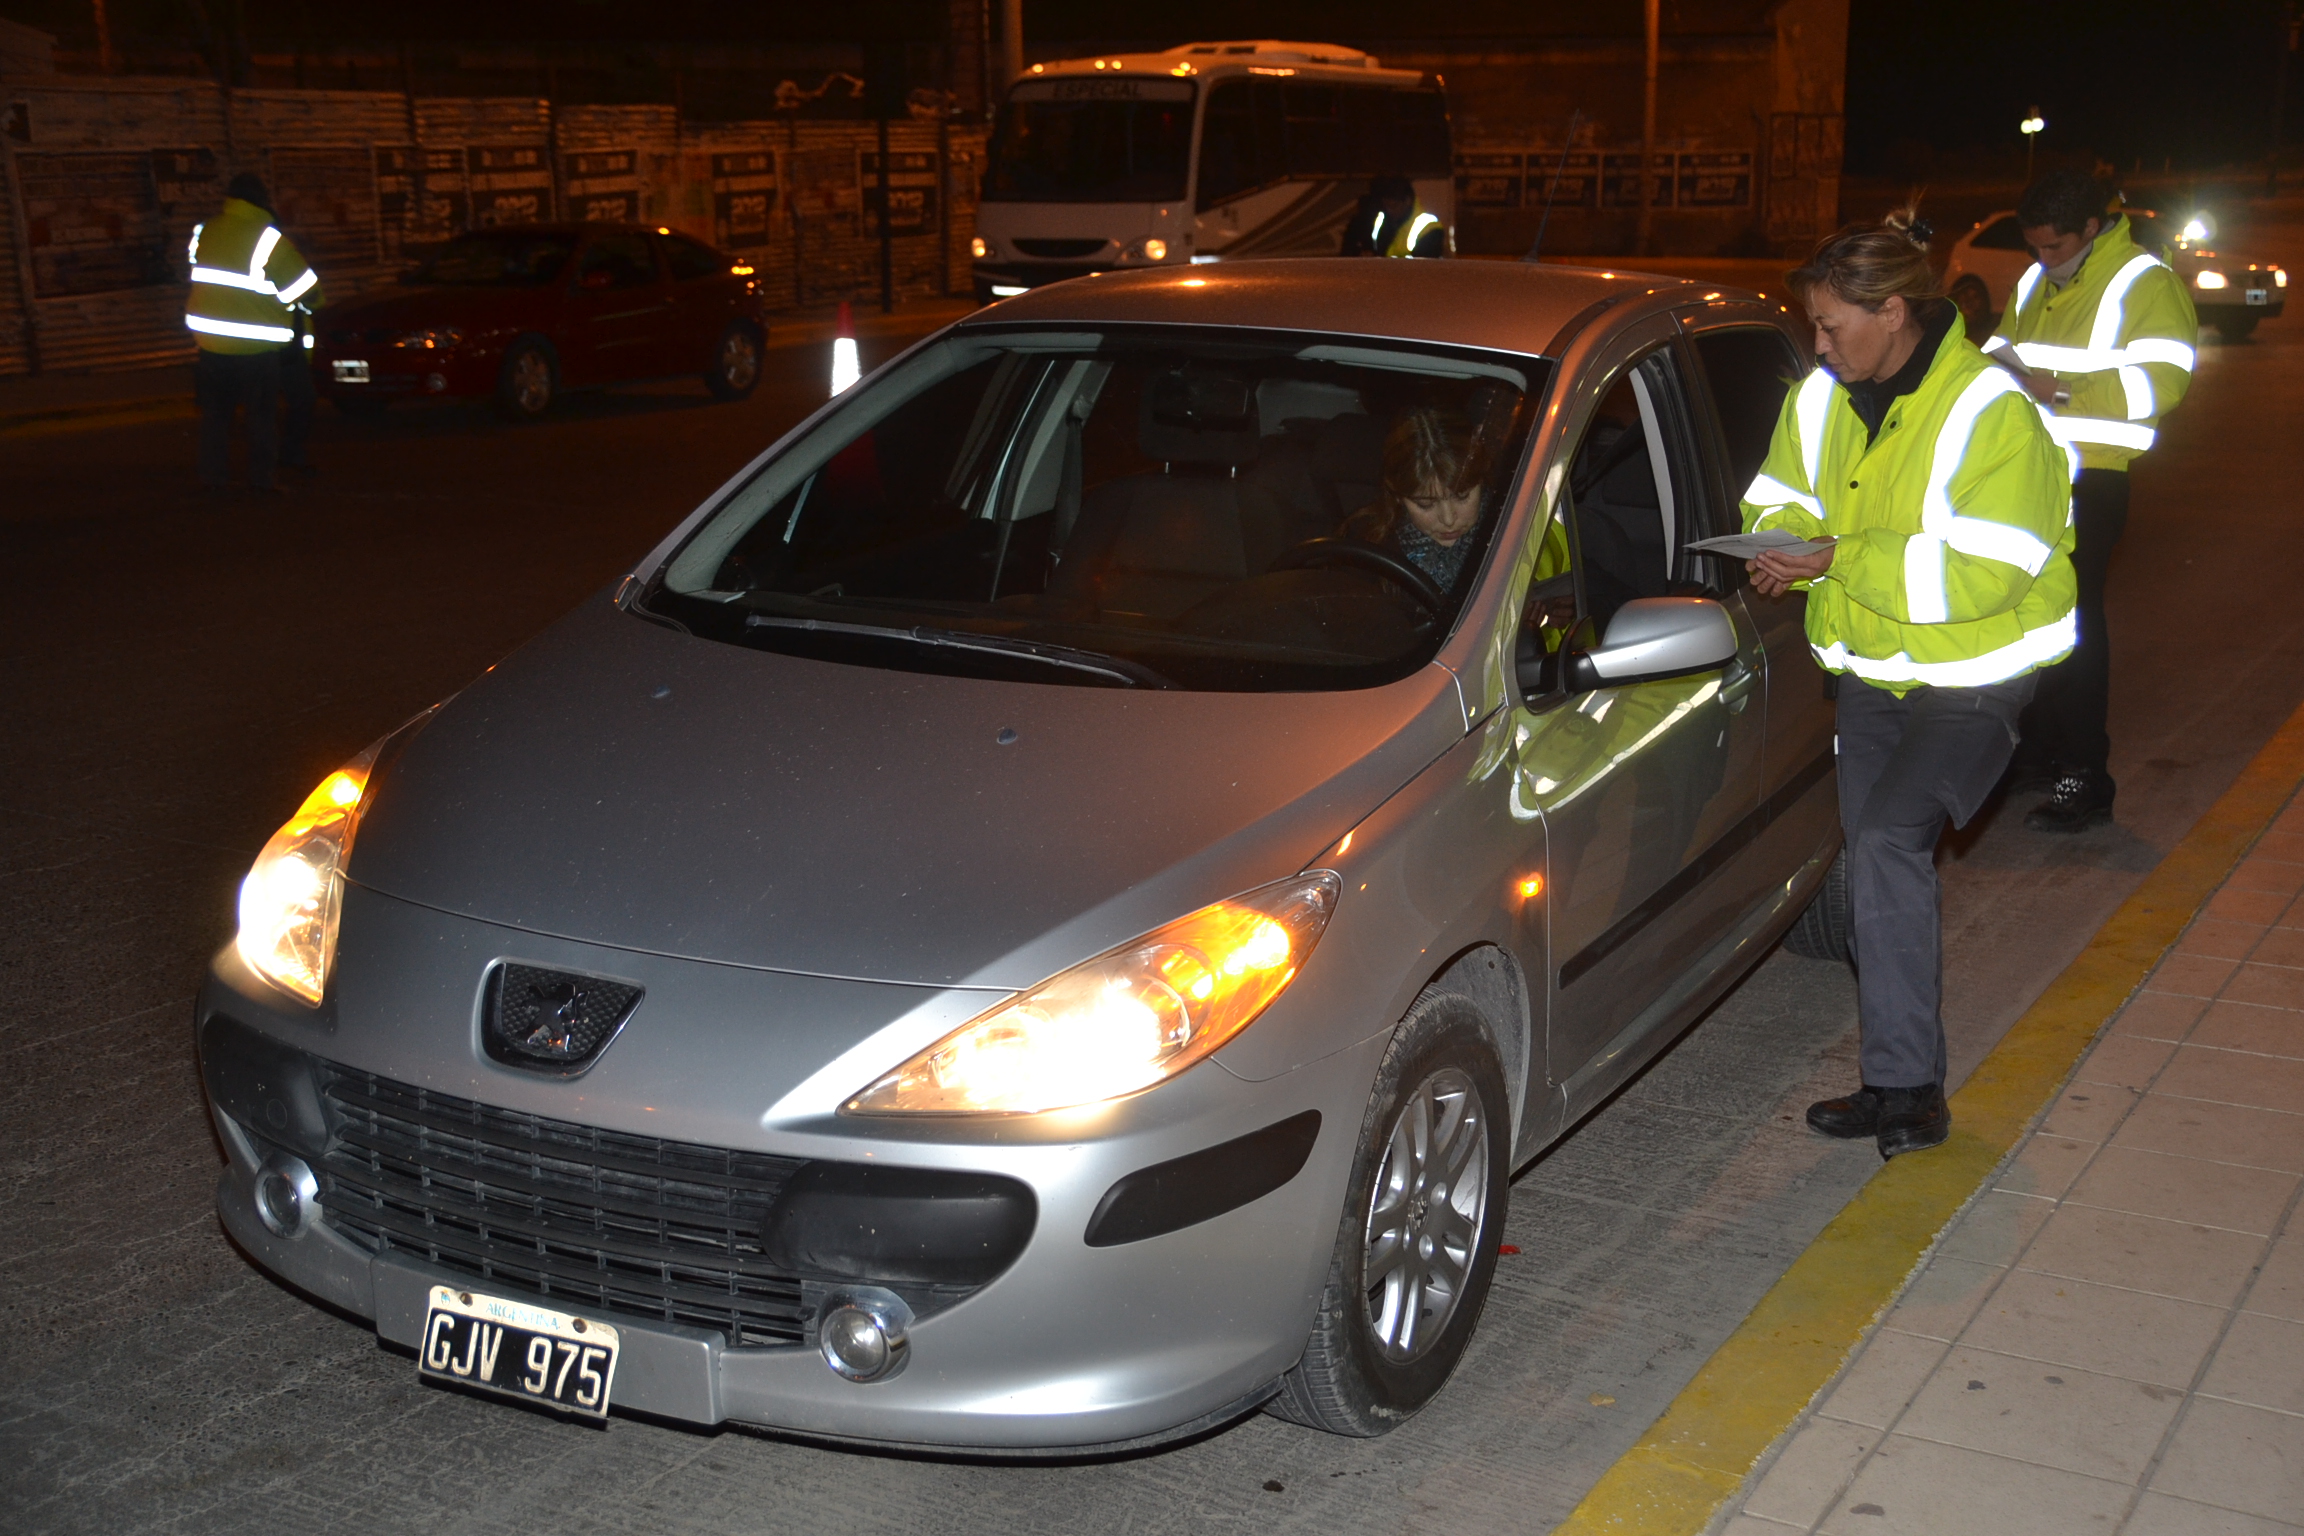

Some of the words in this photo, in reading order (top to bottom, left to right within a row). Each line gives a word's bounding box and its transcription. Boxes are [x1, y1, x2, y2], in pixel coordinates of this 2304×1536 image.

[1053, 81, 1140, 99] ESPECIAL
[486, 1302, 560, 1330] ARGENTINA
[427, 1313, 504, 1382] GJV
[524, 1336, 607, 1406] 975
